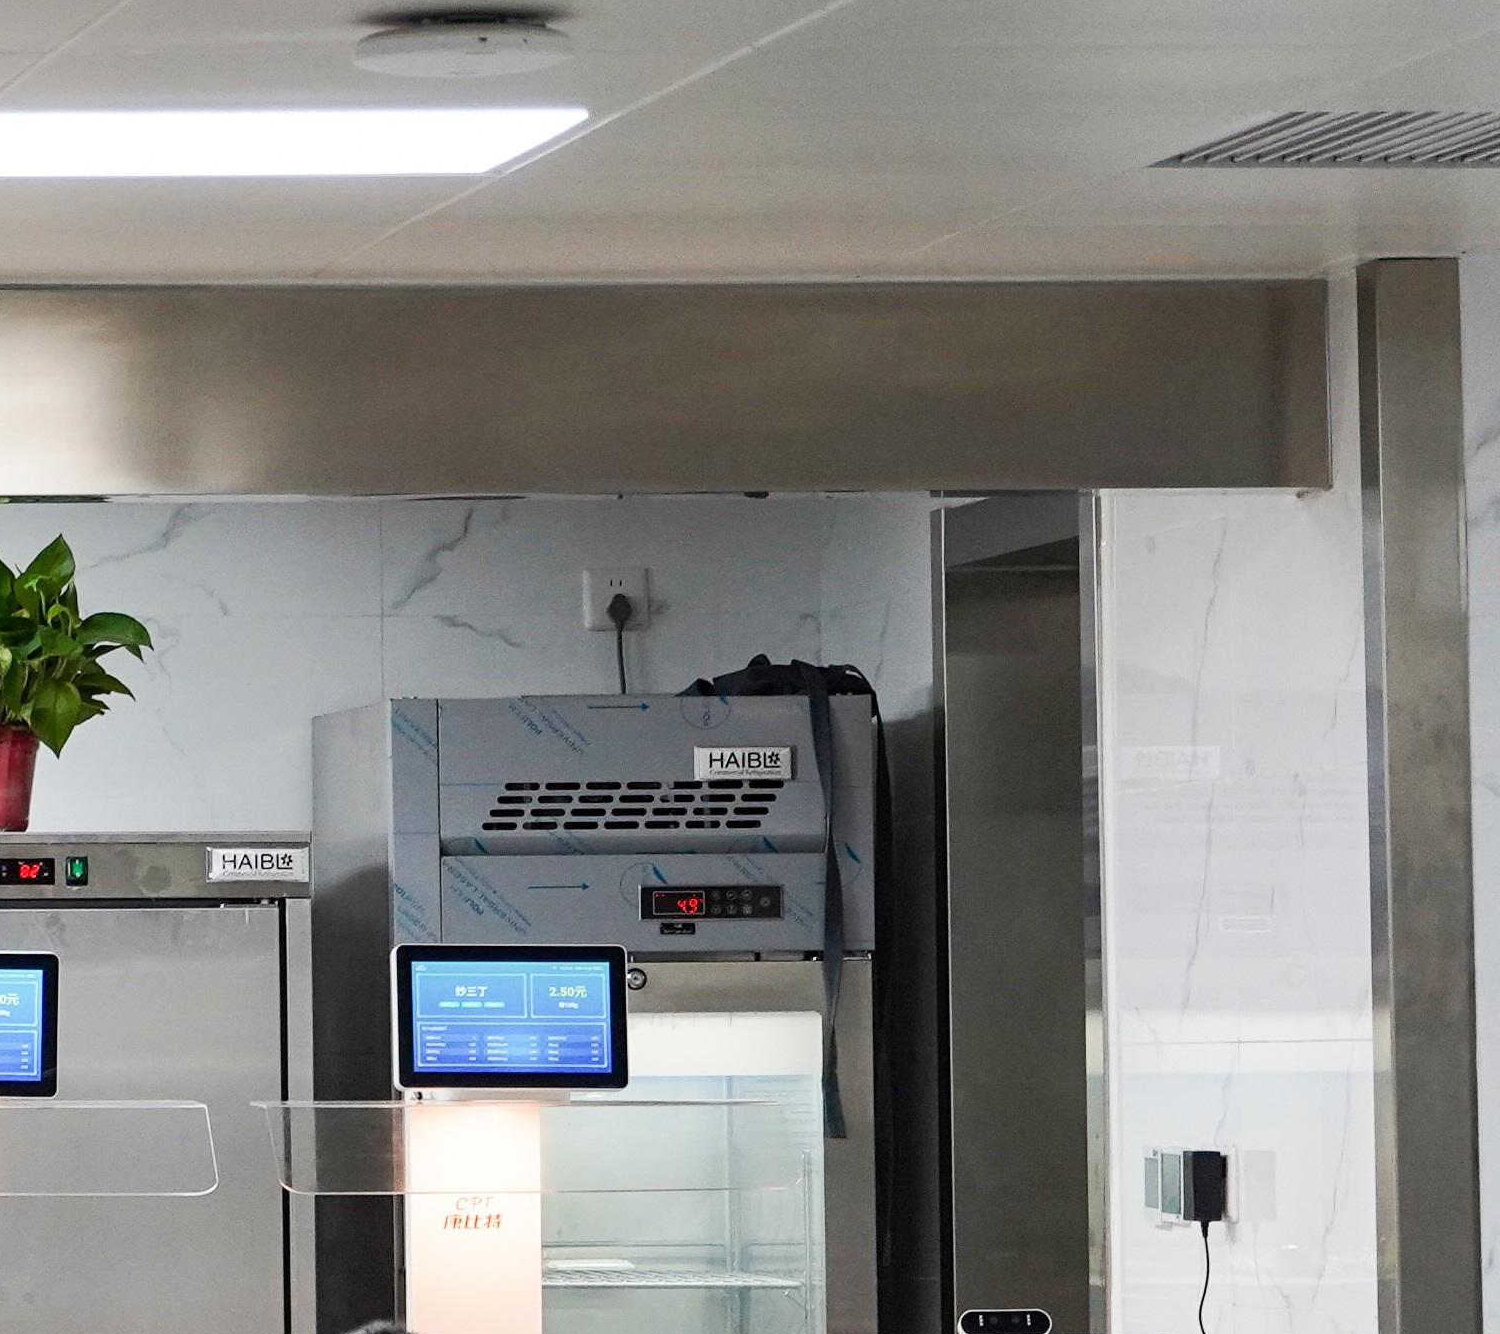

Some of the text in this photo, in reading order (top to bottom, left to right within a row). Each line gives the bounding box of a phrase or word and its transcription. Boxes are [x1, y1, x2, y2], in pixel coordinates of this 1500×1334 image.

[549, 986, 588, 998] 2.50元
[443, 1214, 503, 1229] 康比特
